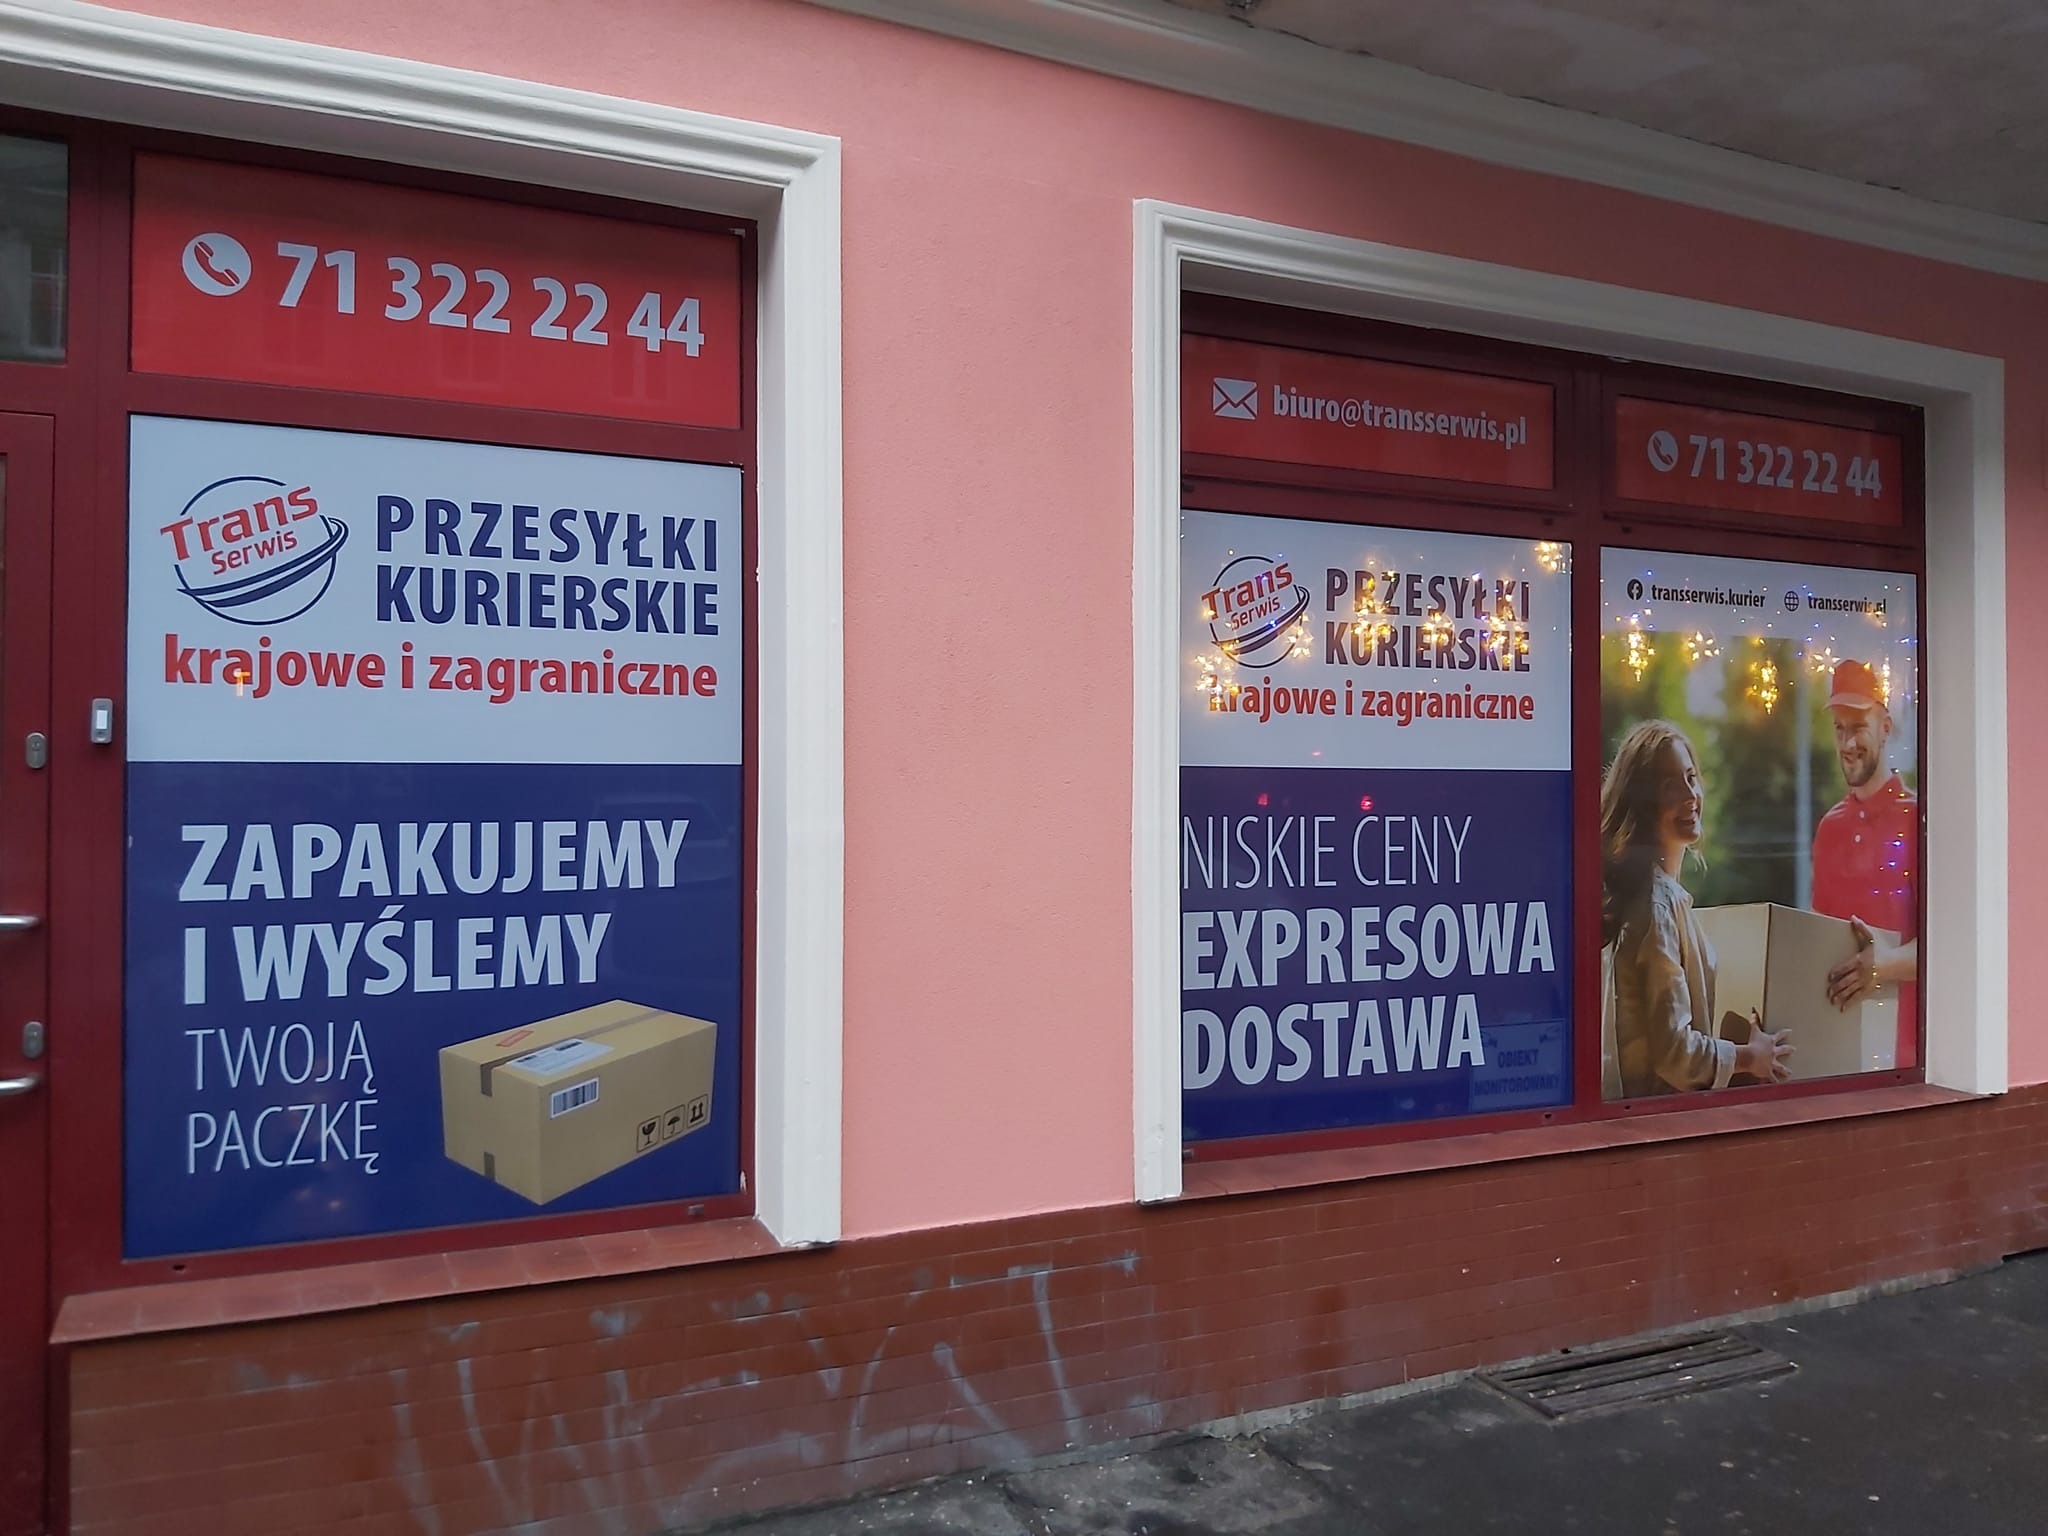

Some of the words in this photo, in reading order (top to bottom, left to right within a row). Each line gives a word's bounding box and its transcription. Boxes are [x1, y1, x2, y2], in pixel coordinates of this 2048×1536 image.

[277, 242, 356, 314] 71
[385, 257, 510, 333] 322
[531, 277, 609, 345] 22
[627, 292, 705, 357] 44
[1273, 384, 1527, 449] biuro@transserwis.pl
[1689, 435, 1725, 480] 71
[1738, 441, 1794, 488] 322
[1803, 450, 1838, 493] 22
[1846, 457, 1882, 498] 44
[160, 486, 318, 561] Trans
[211, 530, 298, 575] Serwis
[376, 495, 718, 572] PRZESYŁKI
[376, 564, 718, 635] KURIERSKIE
[1202, 563, 1293, 620] Trans
[1231, 596, 1281, 631] Serwis
[1326, 568, 1529, 622] PRZESYŁKI
[1652, 584, 1765, 608] transserwis.kurier
[165, 633, 385, 698] krajowe
[402, 642, 414, 689] i
[429, 650, 718, 704] zagraniczne
[1325, 621, 1530, 672] KURIERSKIE
[1346, 680, 1352, 715] i
[1361, 685, 1534, 726] zagraniczne
[179, 820, 689, 901] ZAPAKUJEMY
[1183, 815, 1337, 889] NISKIE
[1352, 815, 1472, 886] CENY
[184, 927, 206, 1004] I
[233, 905, 611, 1001] WYŚLEMY
[1182, 901, 1555, 991] EXPRESOWA
[186, 1021, 377, 1094] TWOJĄ
[1182, 994, 1485, 1090] DOSTAWA
[187, 1099, 379, 1175] PACZKĘ
